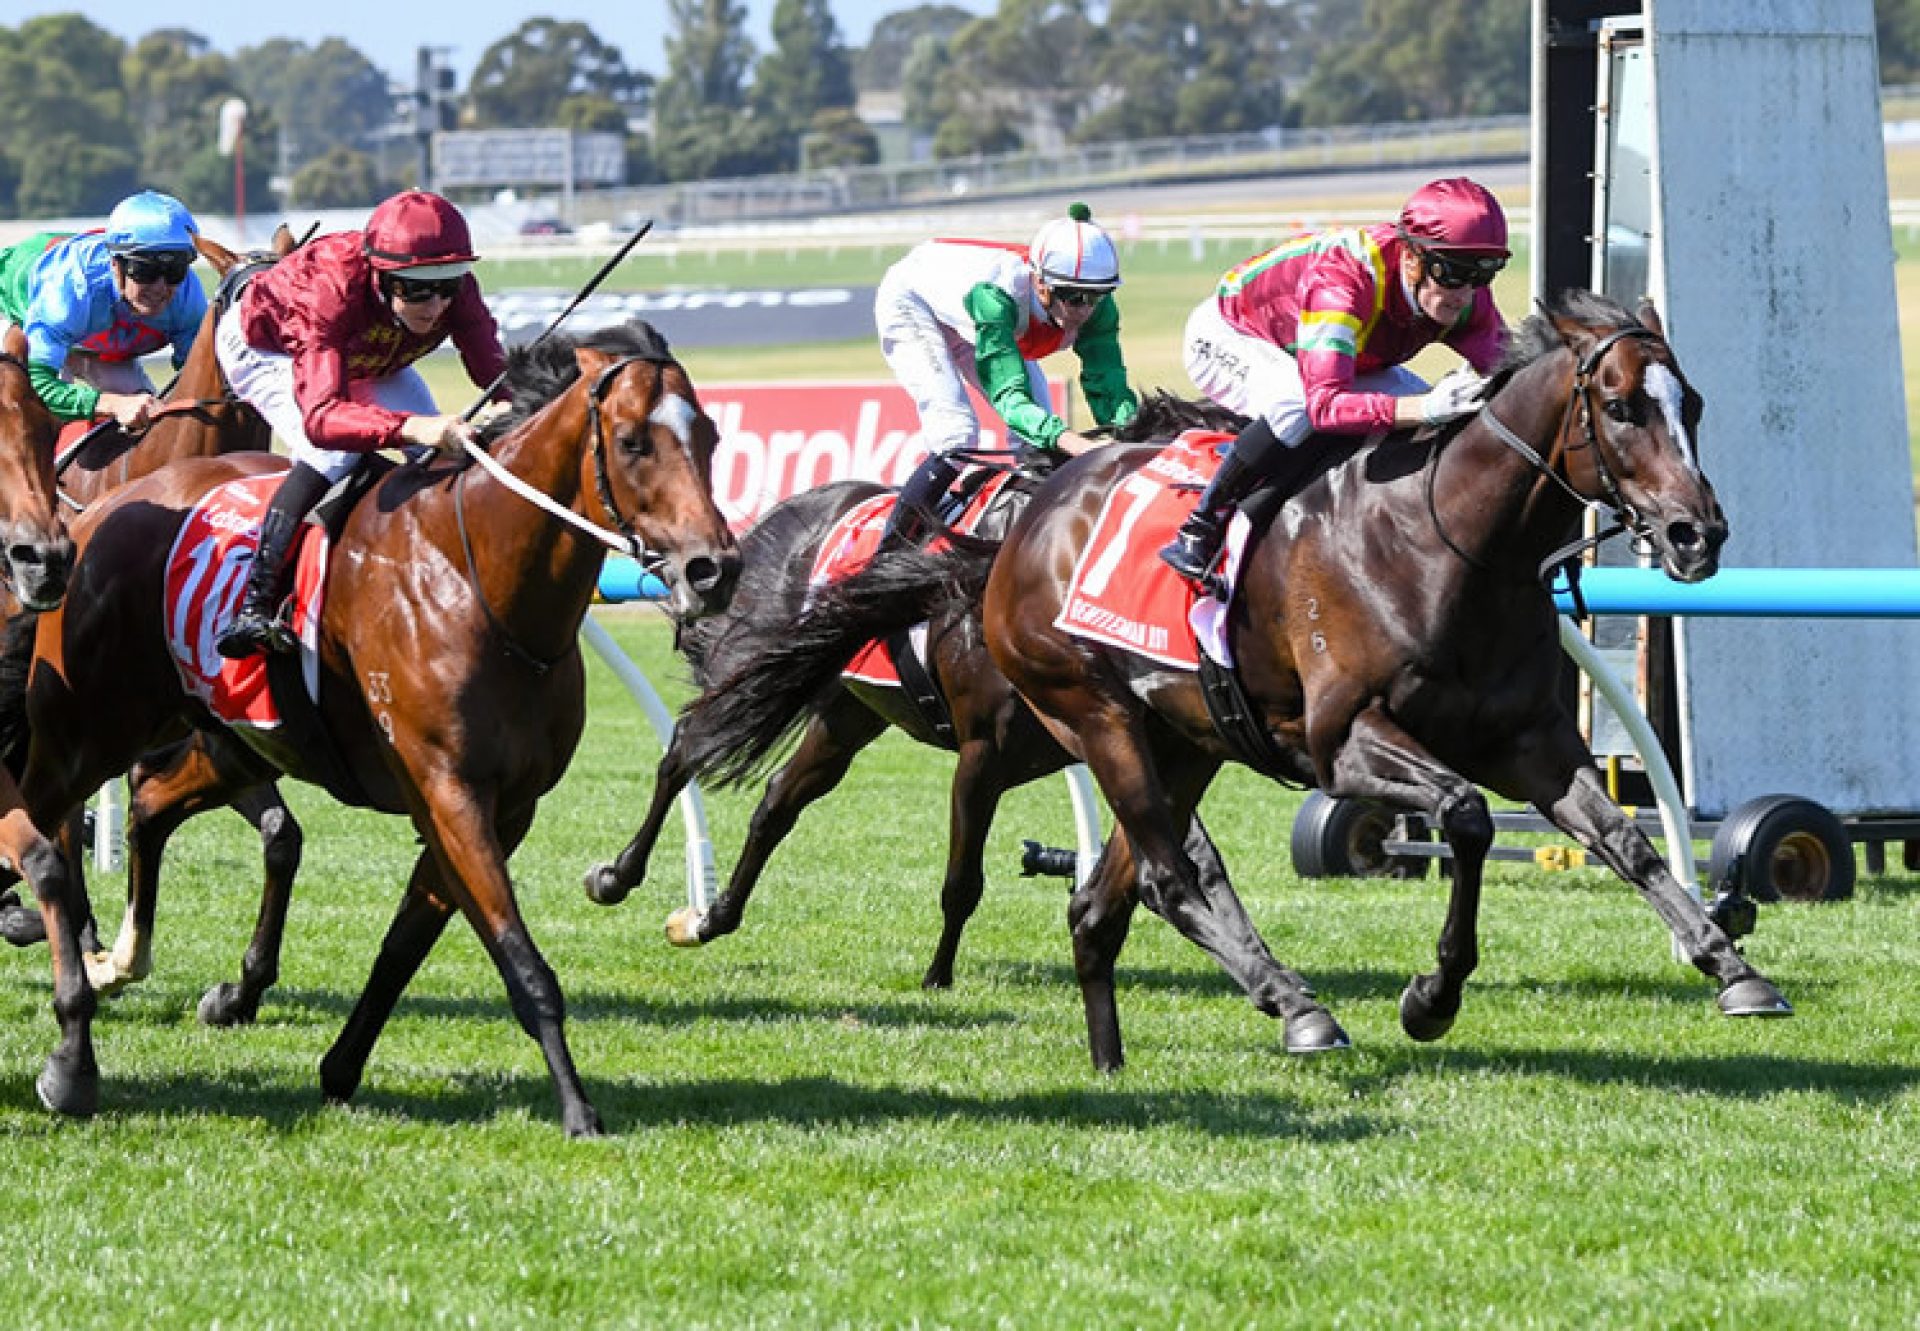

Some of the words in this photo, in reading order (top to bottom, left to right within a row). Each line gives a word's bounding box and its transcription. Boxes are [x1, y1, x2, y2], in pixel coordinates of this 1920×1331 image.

[702, 400, 997, 522] brok
[1079, 472, 1163, 598] 7
[173, 536, 254, 678] 10
[1307, 598, 1320, 621] 2
[1310, 630, 1327, 655] 6
[378, 710, 395, 744] 9
